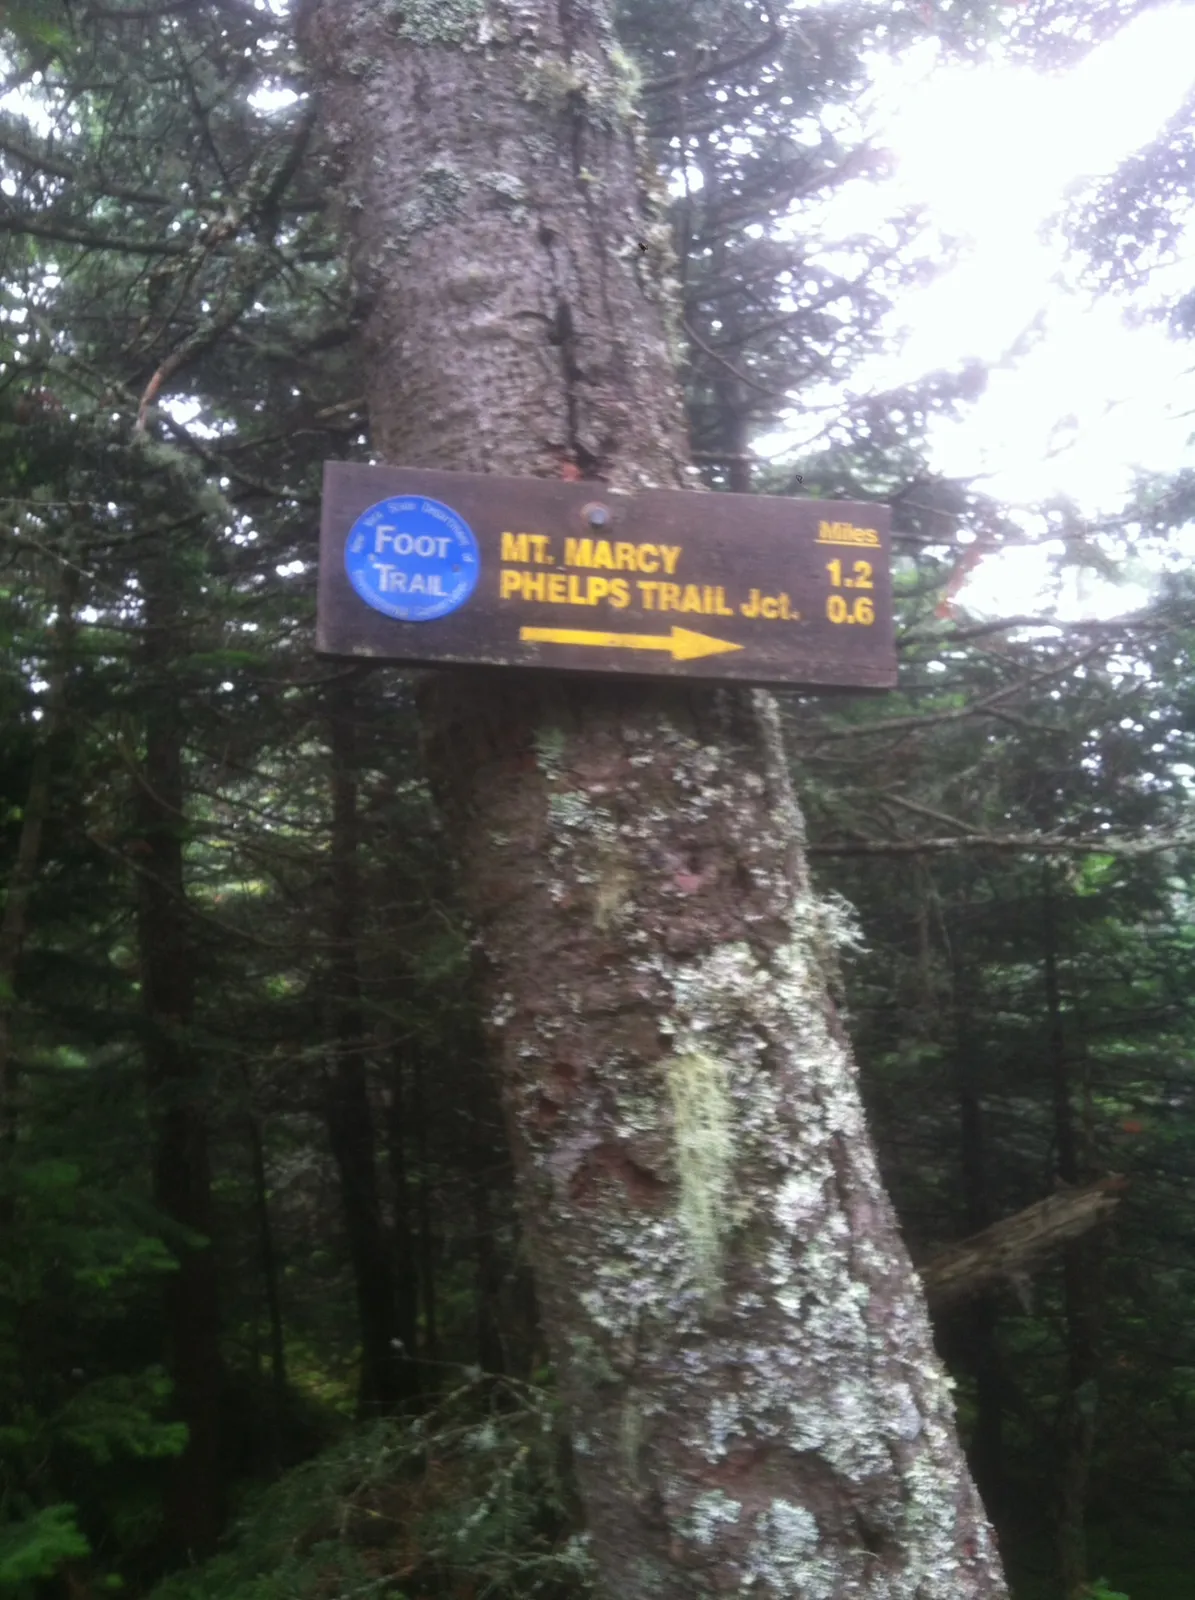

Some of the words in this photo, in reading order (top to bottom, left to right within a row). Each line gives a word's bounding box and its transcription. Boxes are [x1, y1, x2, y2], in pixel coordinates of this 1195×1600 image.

[374, 525, 452, 559] FOOT
[817, 520, 879, 544] Miles
[500, 531, 555, 565] MT.
[563, 536, 682, 575] MARCY
[372, 562, 449, 597] TRAIL
[826, 557, 874, 589] 1.2
[499, 569, 631, 610] PHELPS
[637, 581, 734, 616] TRAIL
[740, 588, 800, 621] Jct.
[826, 595, 875, 626] 0.6
